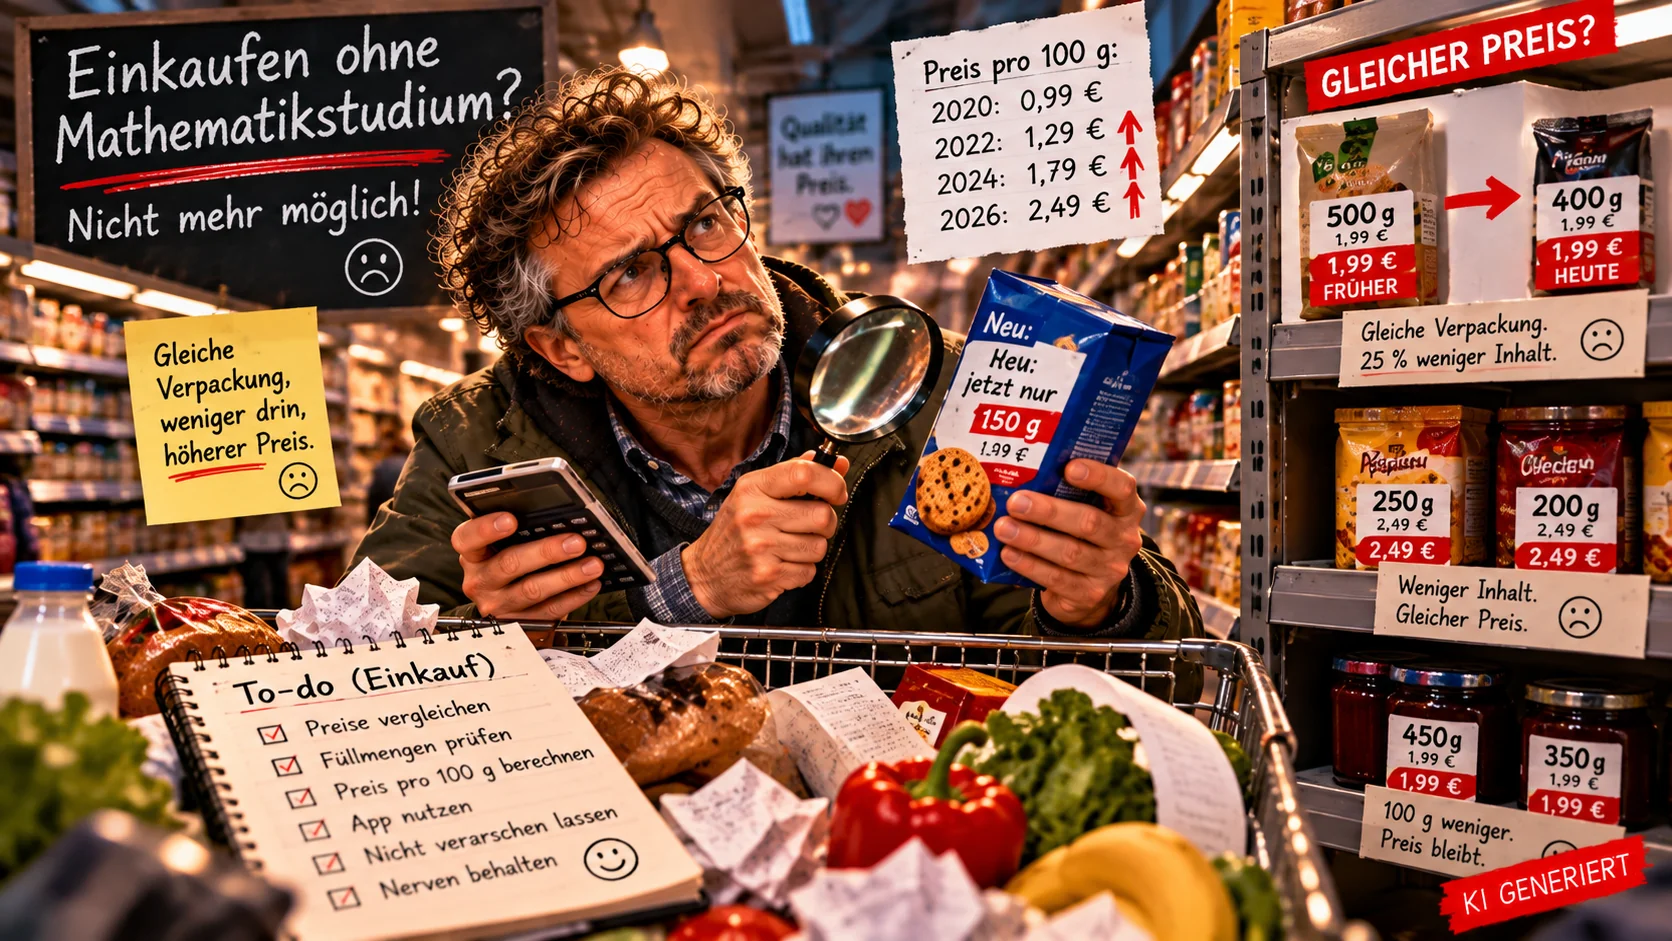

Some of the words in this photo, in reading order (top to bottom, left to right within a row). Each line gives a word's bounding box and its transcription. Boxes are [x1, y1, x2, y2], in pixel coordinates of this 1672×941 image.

[68, 31, 309, 100] Einkaufen
[337, 24, 439, 74] ohne
[924, 58, 980, 84] Preis
[993, 56, 1030, 84] pro
[1042, 40, 1085, 67] 100
[1097, 43, 1117, 69] g:
[1322, 41, 1469, 97] GLEICHER
[1483, 15, 1595, 65] PREIS?
[56, 67, 521, 164] Mathematikstudium?
[932, 95, 999, 123] 2020:
[1021, 84, 1072, 113] 0,99
[1084, 81, 1102, 102] €
[935, 132, 1002, 159] 2022:
[1025, 121, 1073, 150] 1,29
[1086, 118, 1105, 139] €
[938, 168, 1004, 195] 2024:
[1028, 158, 1075, 187] 1,79
[1089, 155, 1107, 176] €
[68, 203, 159, 242] Nicht
[180, 194, 262, 233] mehr
[283, 179, 419, 236] möglich!
[941, 204, 1007, 231] 2026:
[1029, 195, 1079, 223] 2,49
[1092, 192, 1110, 213] €
[1602, 214, 1614, 227] €
[1336, 231, 1368, 247] 1,99
[1376, 229, 1388, 241] €
[1553, 240, 1598, 262] 1,99
[1607, 238, 1622, 255] €
[1328, 254, 1372, 277] 1,99
[1381, 252, 1396, 269] €
[1556, 263, 1619, 284] HEUTE
[983, 311, 1032, 340] Neu:
[1362, 319, 1424, 341] Gleiche
[1435, 313, 1547, 343] Verpackung.
[154, 338, 234, 367] Gleiche
[1361, 351, 1384, 370] 25
[1393, 349, 1407, 368] %
[1417, 349, 1486, 372] weniger
[1495, 342, 1556, 363] Inhalt.
[157, 368, 290, 403] Verpackung,
[962, 372, 1013, 397] jetzt
[1020, 386, 1057, 402] nur
[161, 408, 245, 435] weniger
[257, 398, 305, 421] drin,
[982, 409, 1020, 431] 150
[1025, 419, 1041, 440] g
[164, 440, 246, 466] höherer
[256, 431, 313, 454] Preis.
[1377, 518, 1409, 532] 2,49
[1416, 519, 1427, 531] €
[1538, 523, 1575, 538] 2,49
[1582, 525, 1593, 537] €
[1370, 541, 1413, 560] 2,49
[1421, 542, 1434, 559] €
[1530, 548, 1576, 567] 2,49
[1585, 549, 1600, 566] €
[1399, 575, 1469, 603] Weniger
[1477, 579, 1536, 602] Inhalt.
[1396, 603, 1469, 627] Gleicher
[1479, 609, 1527, 632] Preis.
[233, 674, 334, 705] To-do
[352, 653, 494, 694] (Einkauf)
[305, 718, 369, 736] Preise
[378, 700, 490, 728] vergleichen
[320, 743, 436, 768] Füllmengen
[445, 728, 512, 755] prüfen
[1409, 751, 1438, 765] 1,99
[1445, 755, 1455, 768] €
[334, 780, 388, 800] Preis
[397, 778, 429, 796] pro
[437, 765, 473, 783] 100
[483, 767, 495, 782] g
[499, 749, 594, 773] berechnen
[1401, 772, 1439, 791] 1,99
[1447, 778, 1461, 794] €
[1588, 777, 1598, 790] €
[353, 815, 391, 835] App
[402, 803, 472, 823] nutzen
[1385, 801, 1415, 822] 100
[1422, 815, 1432, 832] g
[1442, 818, 1513, 844] weniger.
[1590, 801, 1604, 818] €
[364, 841, 426, 864] Nicht
[436, 821, 548, 851] verarschen
[553, 809, 618, 828] lassen
[1381, 828, 1422, 854] Preis
[1432, 837, 1484, 866] bleibt.
[379, 876, 459, 899] Nerven
[465, 856, 557, 882] behalten
